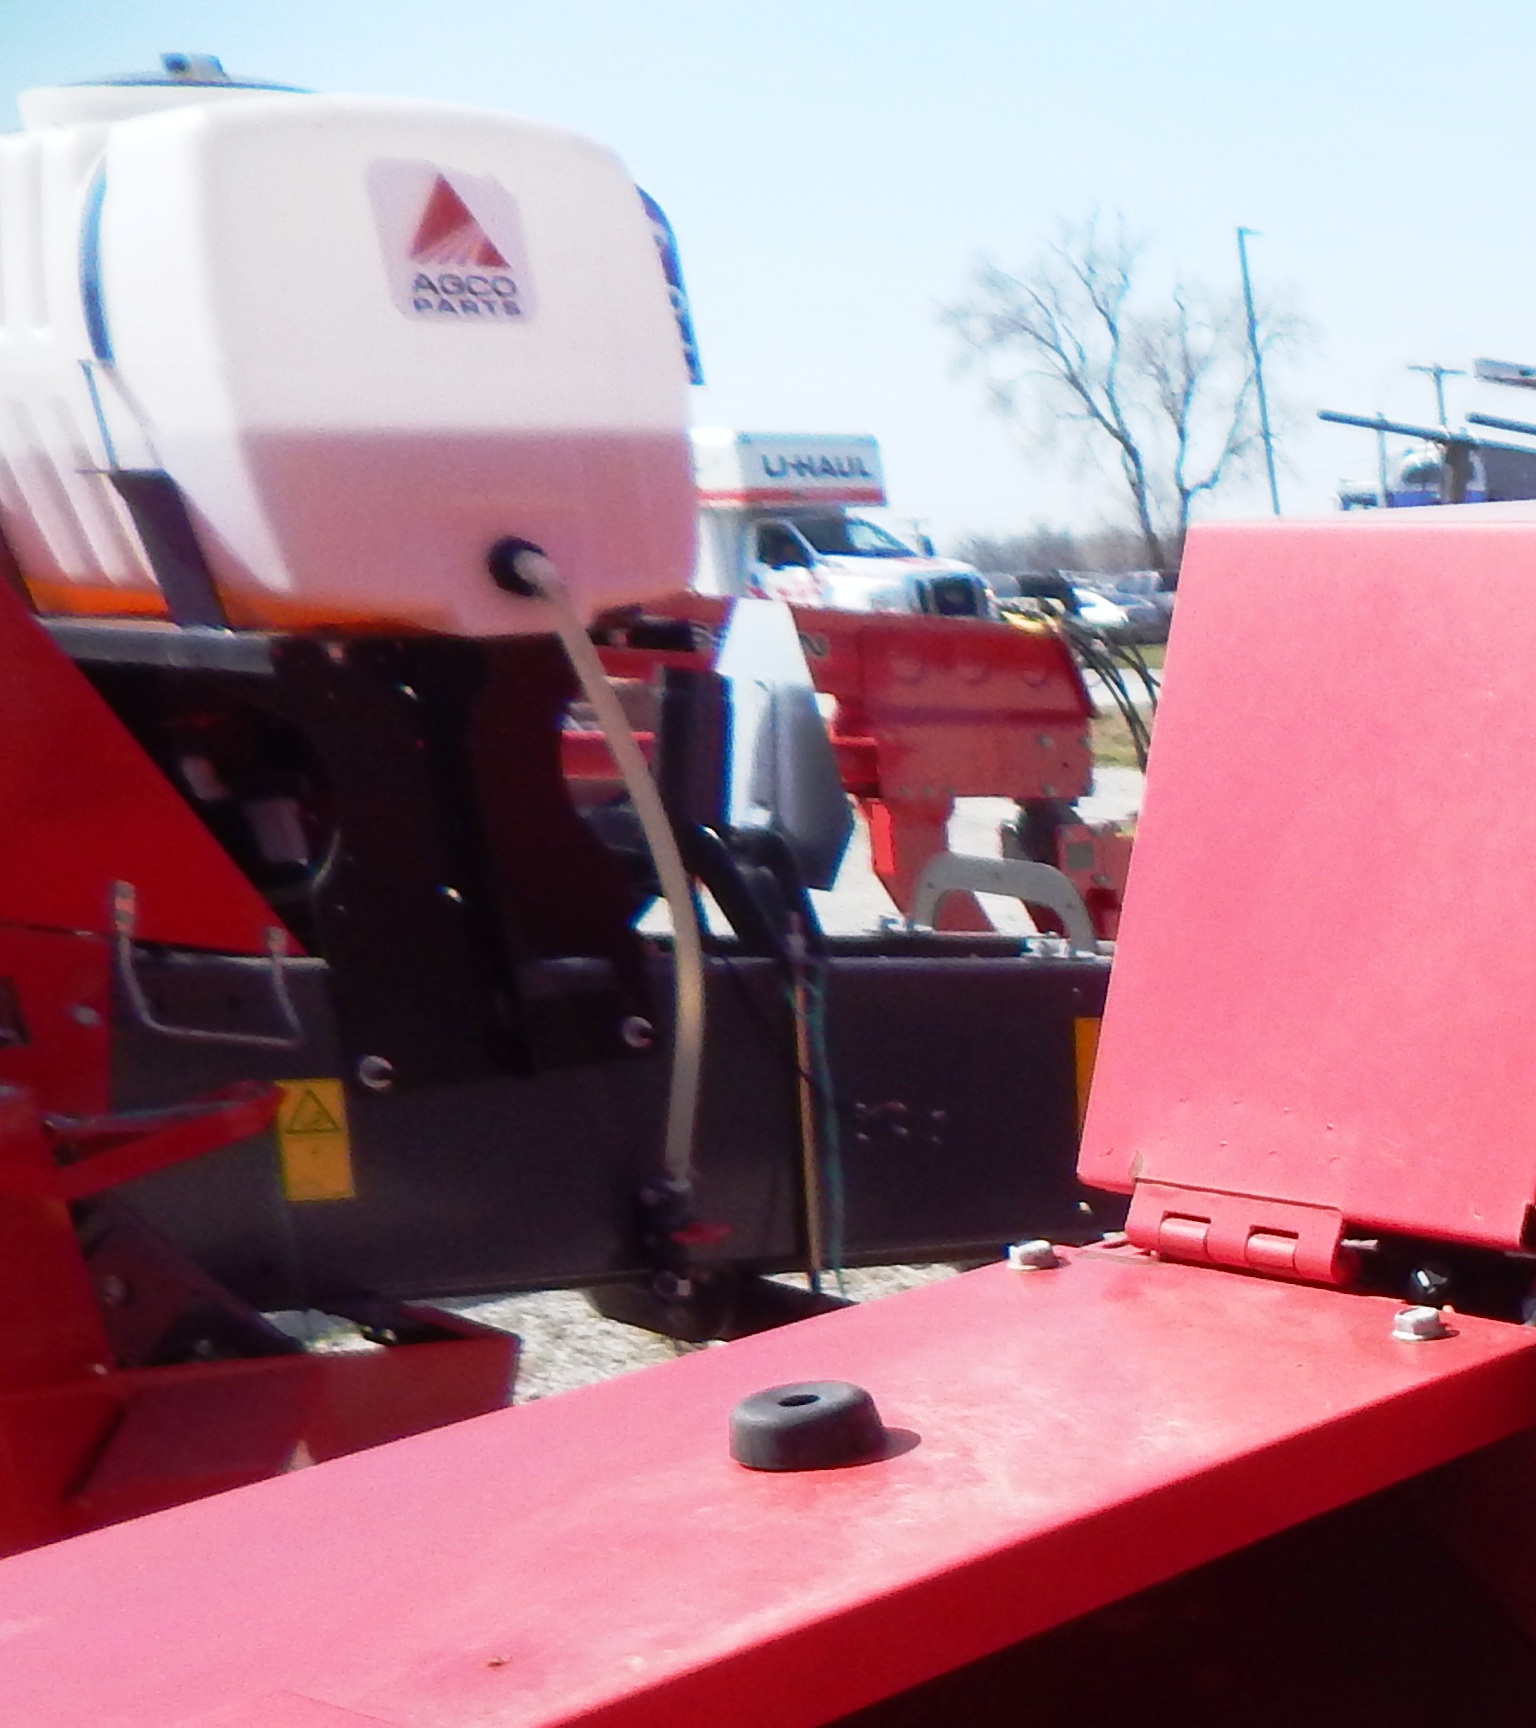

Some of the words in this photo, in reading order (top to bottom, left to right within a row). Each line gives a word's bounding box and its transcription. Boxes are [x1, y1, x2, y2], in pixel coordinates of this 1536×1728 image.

[412, 272, 517, 298] AGCO
[412, 298, 521, 316] PARTS
[761, 454, 871, 478] U-HAUL
